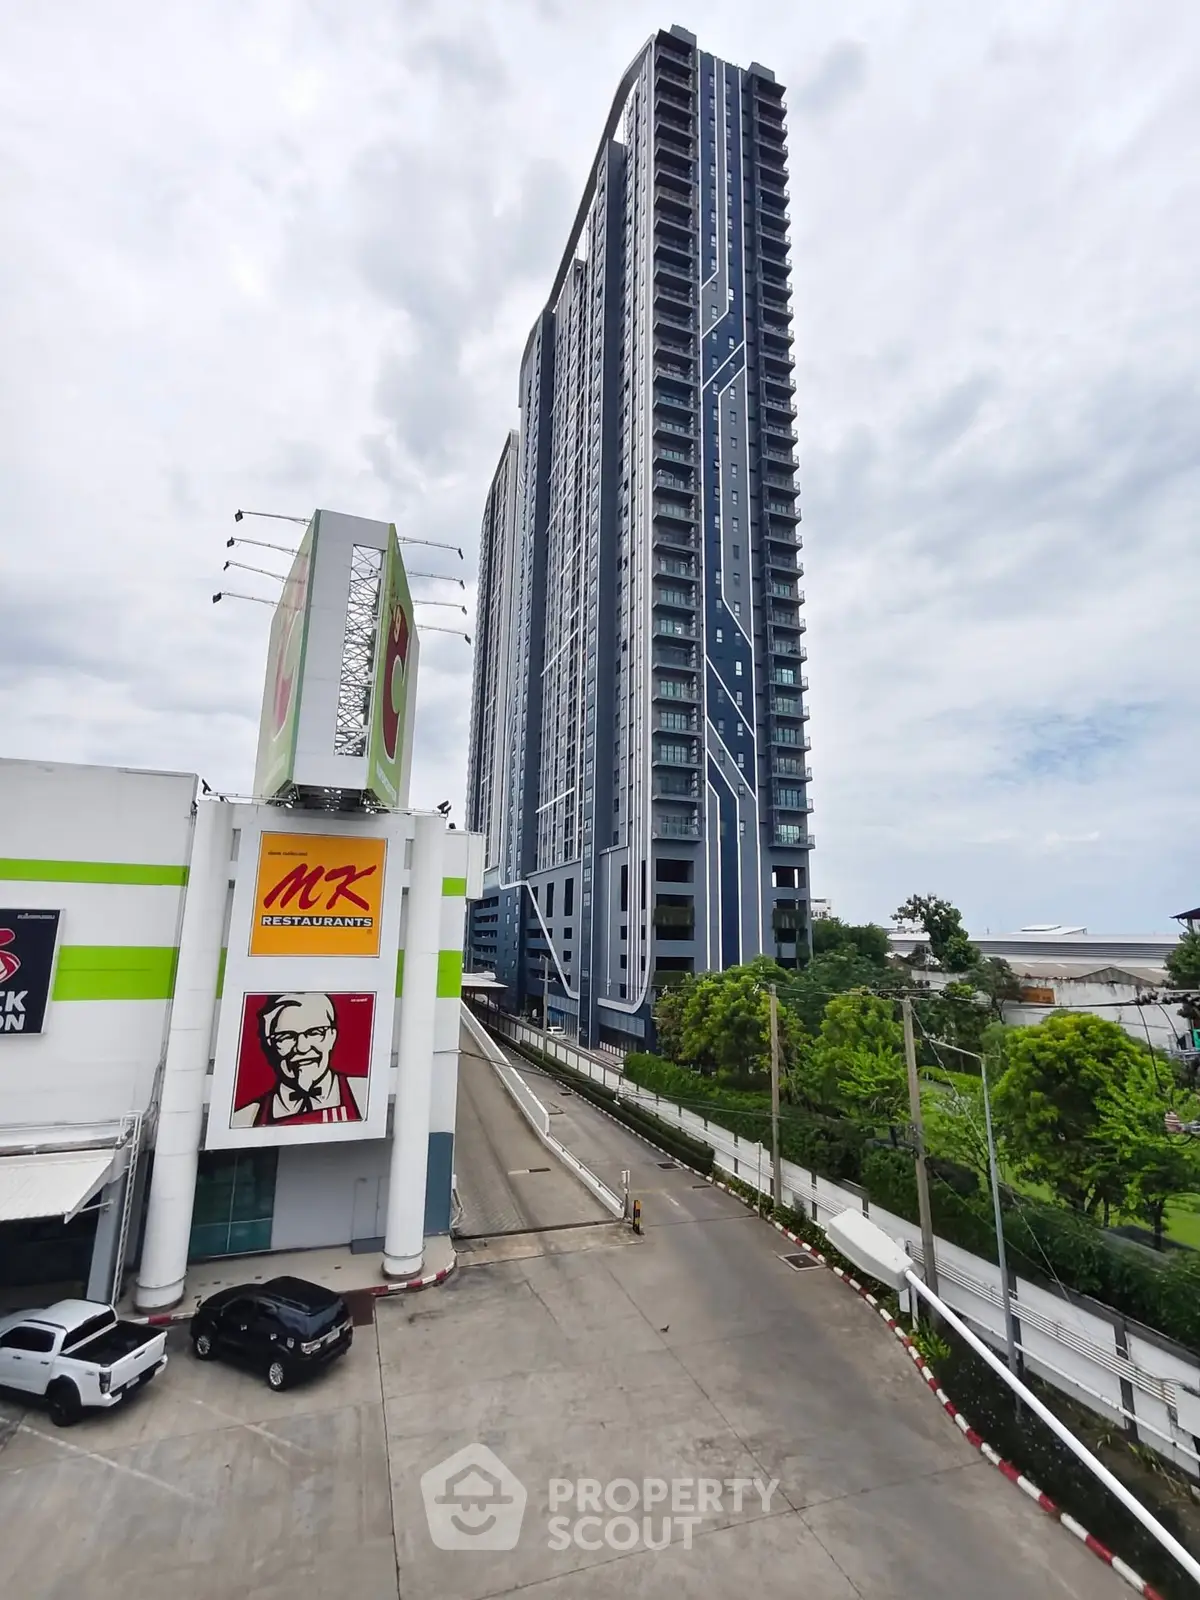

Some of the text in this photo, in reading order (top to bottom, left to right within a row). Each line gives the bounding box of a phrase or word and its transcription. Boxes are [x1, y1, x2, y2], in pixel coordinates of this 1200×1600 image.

[263, 863, 377, 912] MK
[262, 916, 373, 927] RESTAURANTS
[0, 1014, 25, 1031] N
